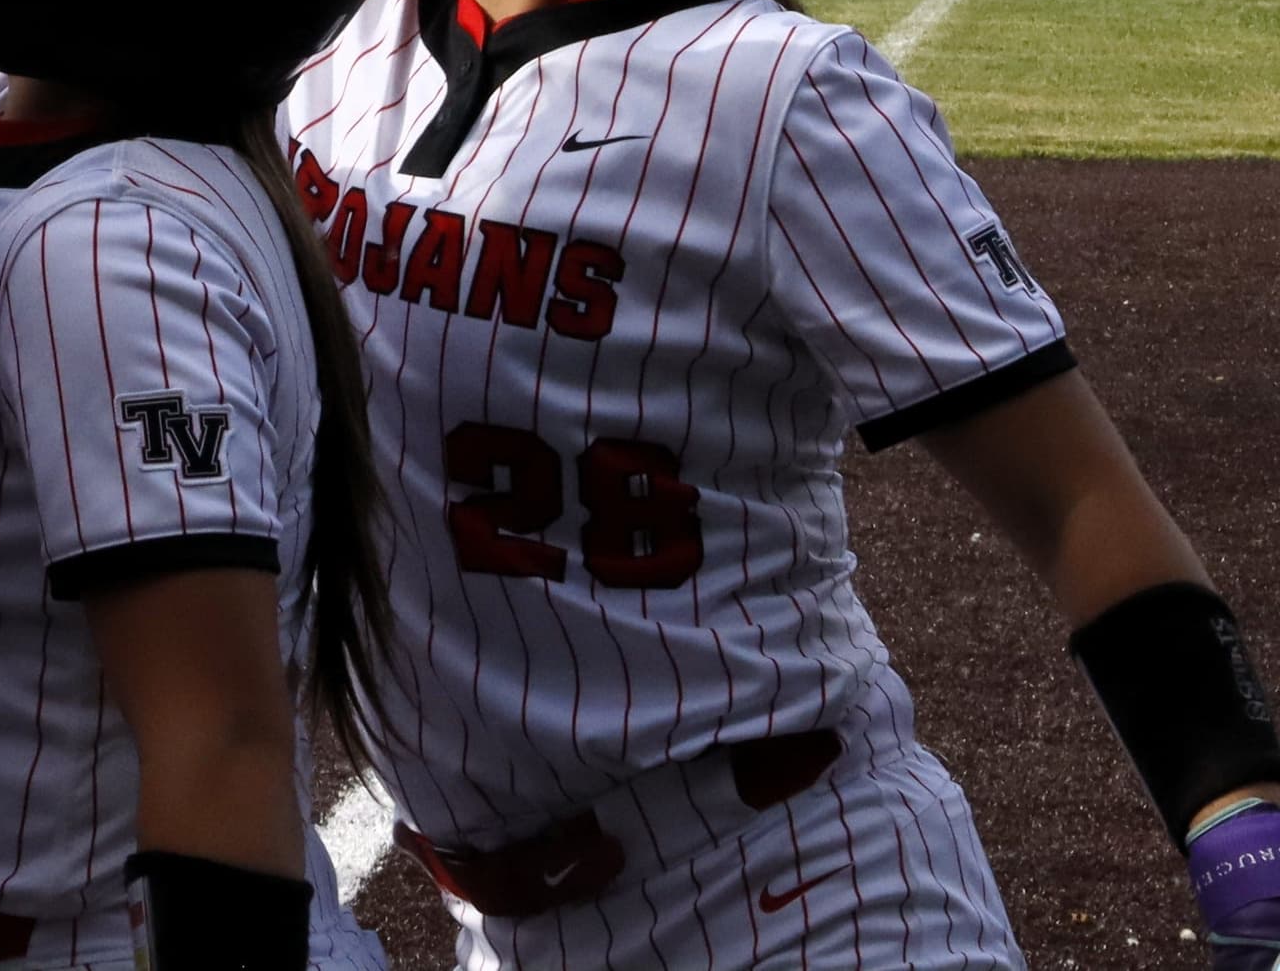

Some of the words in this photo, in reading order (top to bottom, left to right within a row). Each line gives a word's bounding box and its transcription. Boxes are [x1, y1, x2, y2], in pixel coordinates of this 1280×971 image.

[289, 135, 627, 343] ROJANS
[121, 395, 229, 479] TV
[444, 420, 705, 589] 28
